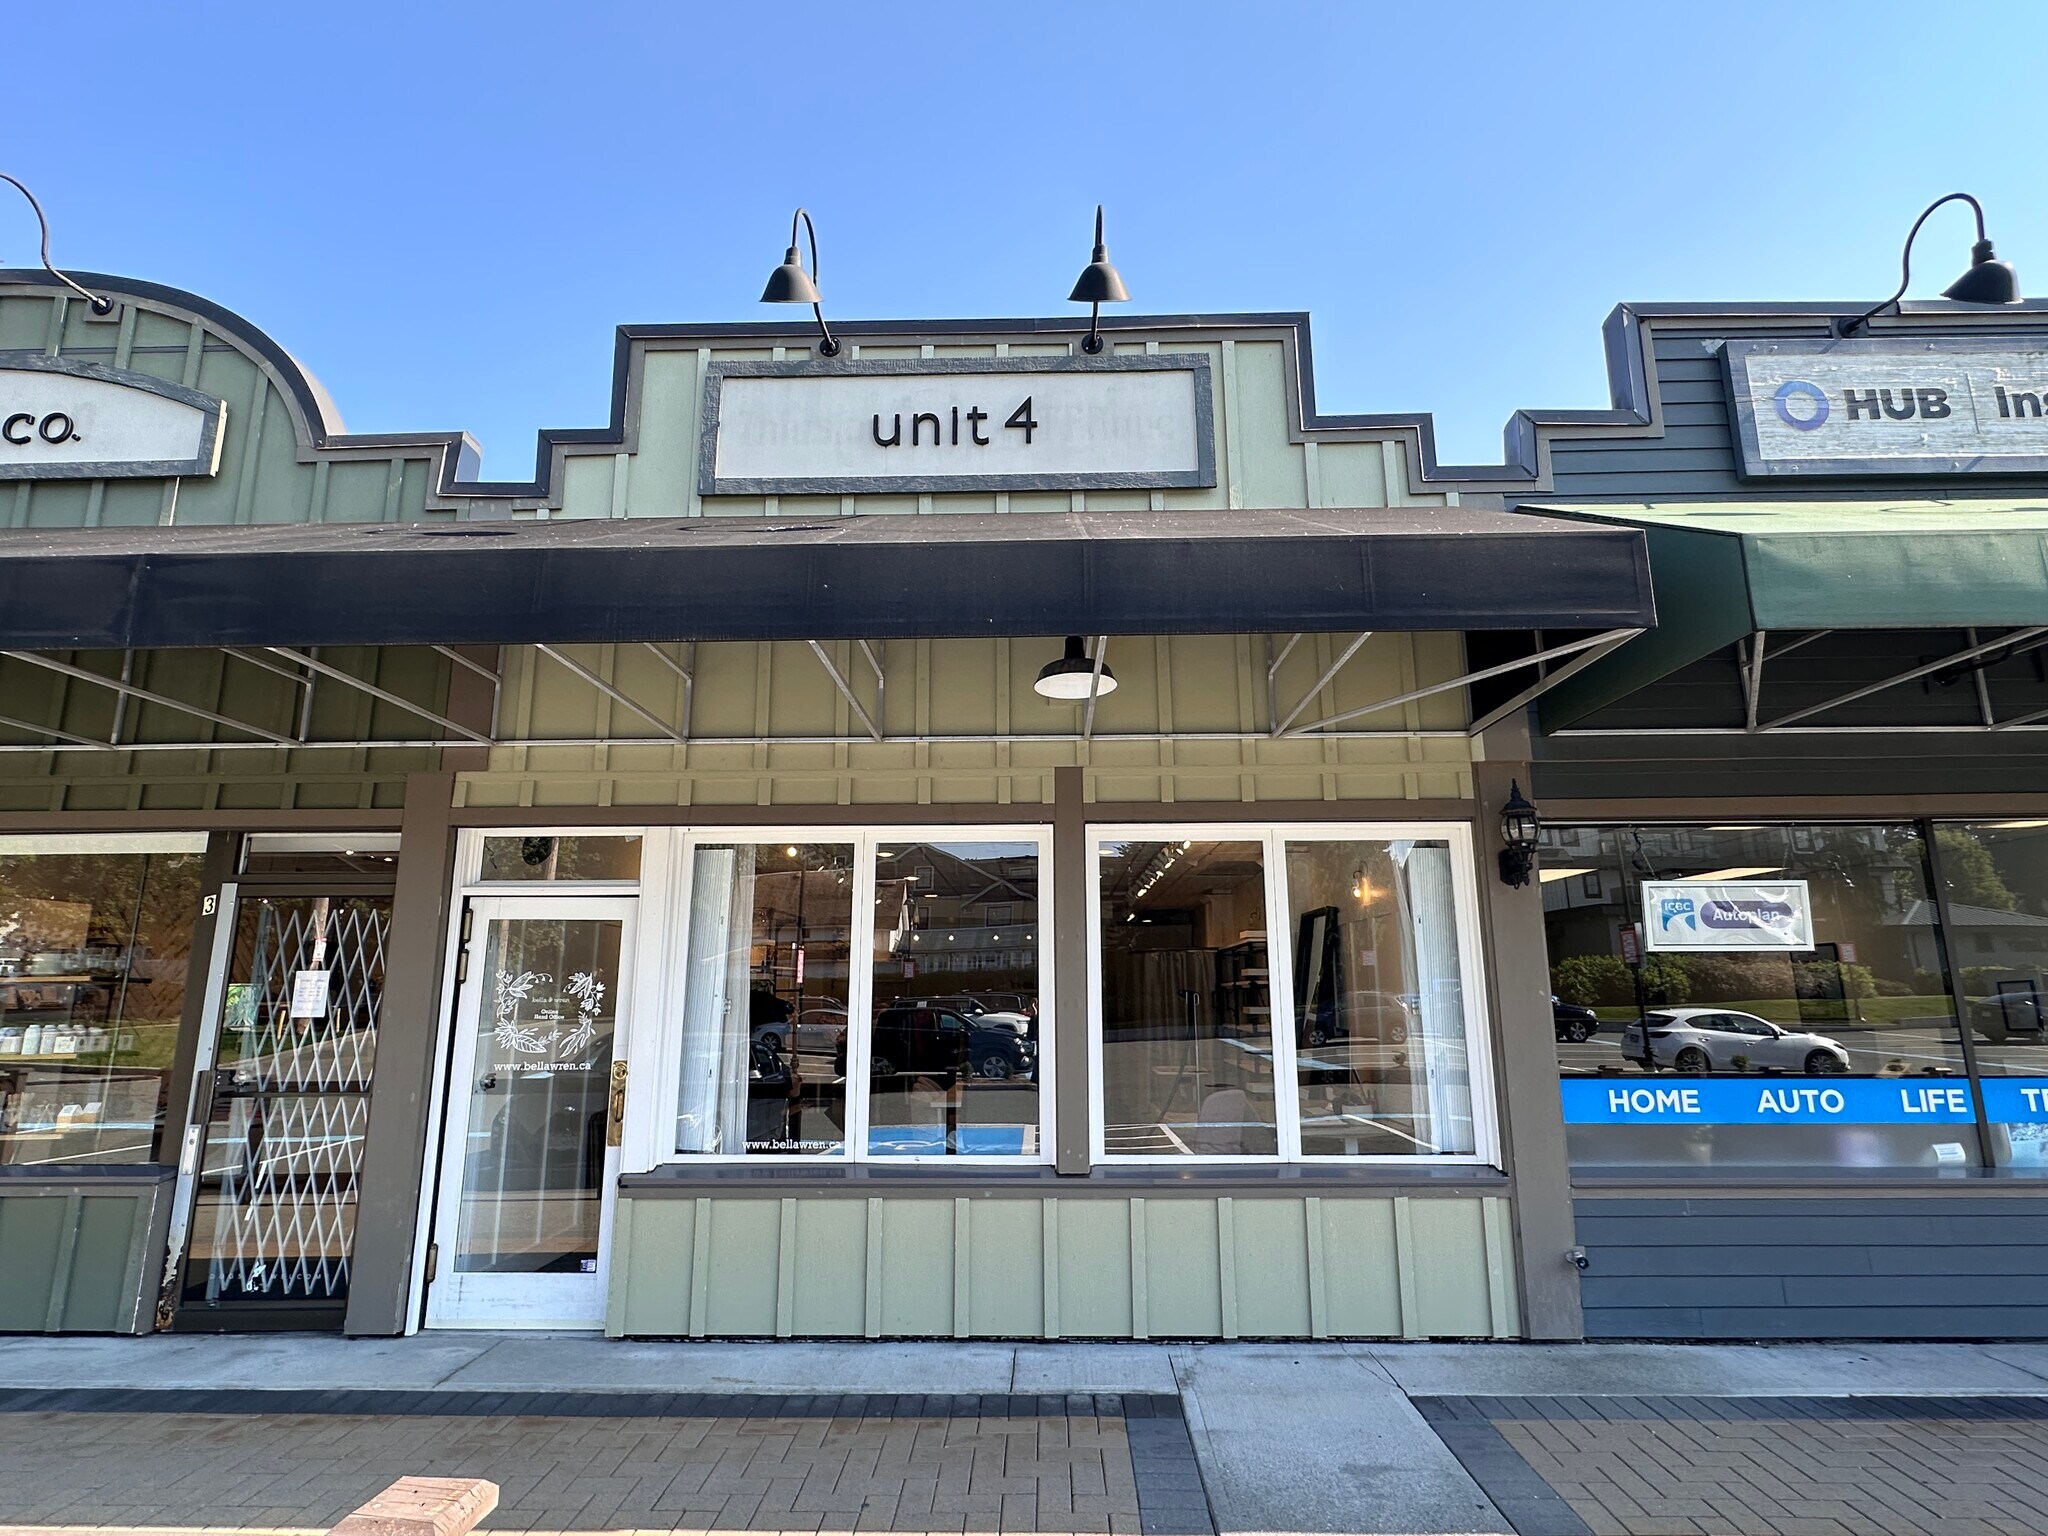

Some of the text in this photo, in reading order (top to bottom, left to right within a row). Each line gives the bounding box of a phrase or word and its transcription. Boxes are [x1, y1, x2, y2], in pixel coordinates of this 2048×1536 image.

[1843, 388, 1951, 420] HUB
[872, 405, 990, 448] unit
[1004, 396, 1038, 445] 4
[205, 897, 214, 913] 3
[1664, 901, 1691, 912] ICBC
[1713, 907, 1781, 925] Autoplan
[493, 1061, 592, 1071] www.bellawren.ca
[1608, 1089, 1700, 1113] HOME
[1757, 1089, 1845, 1113] AUTO
[1900, 1089, 1967, 1113] LIFE
[742, 1139, 841, 1150] www.bellawren.ca
